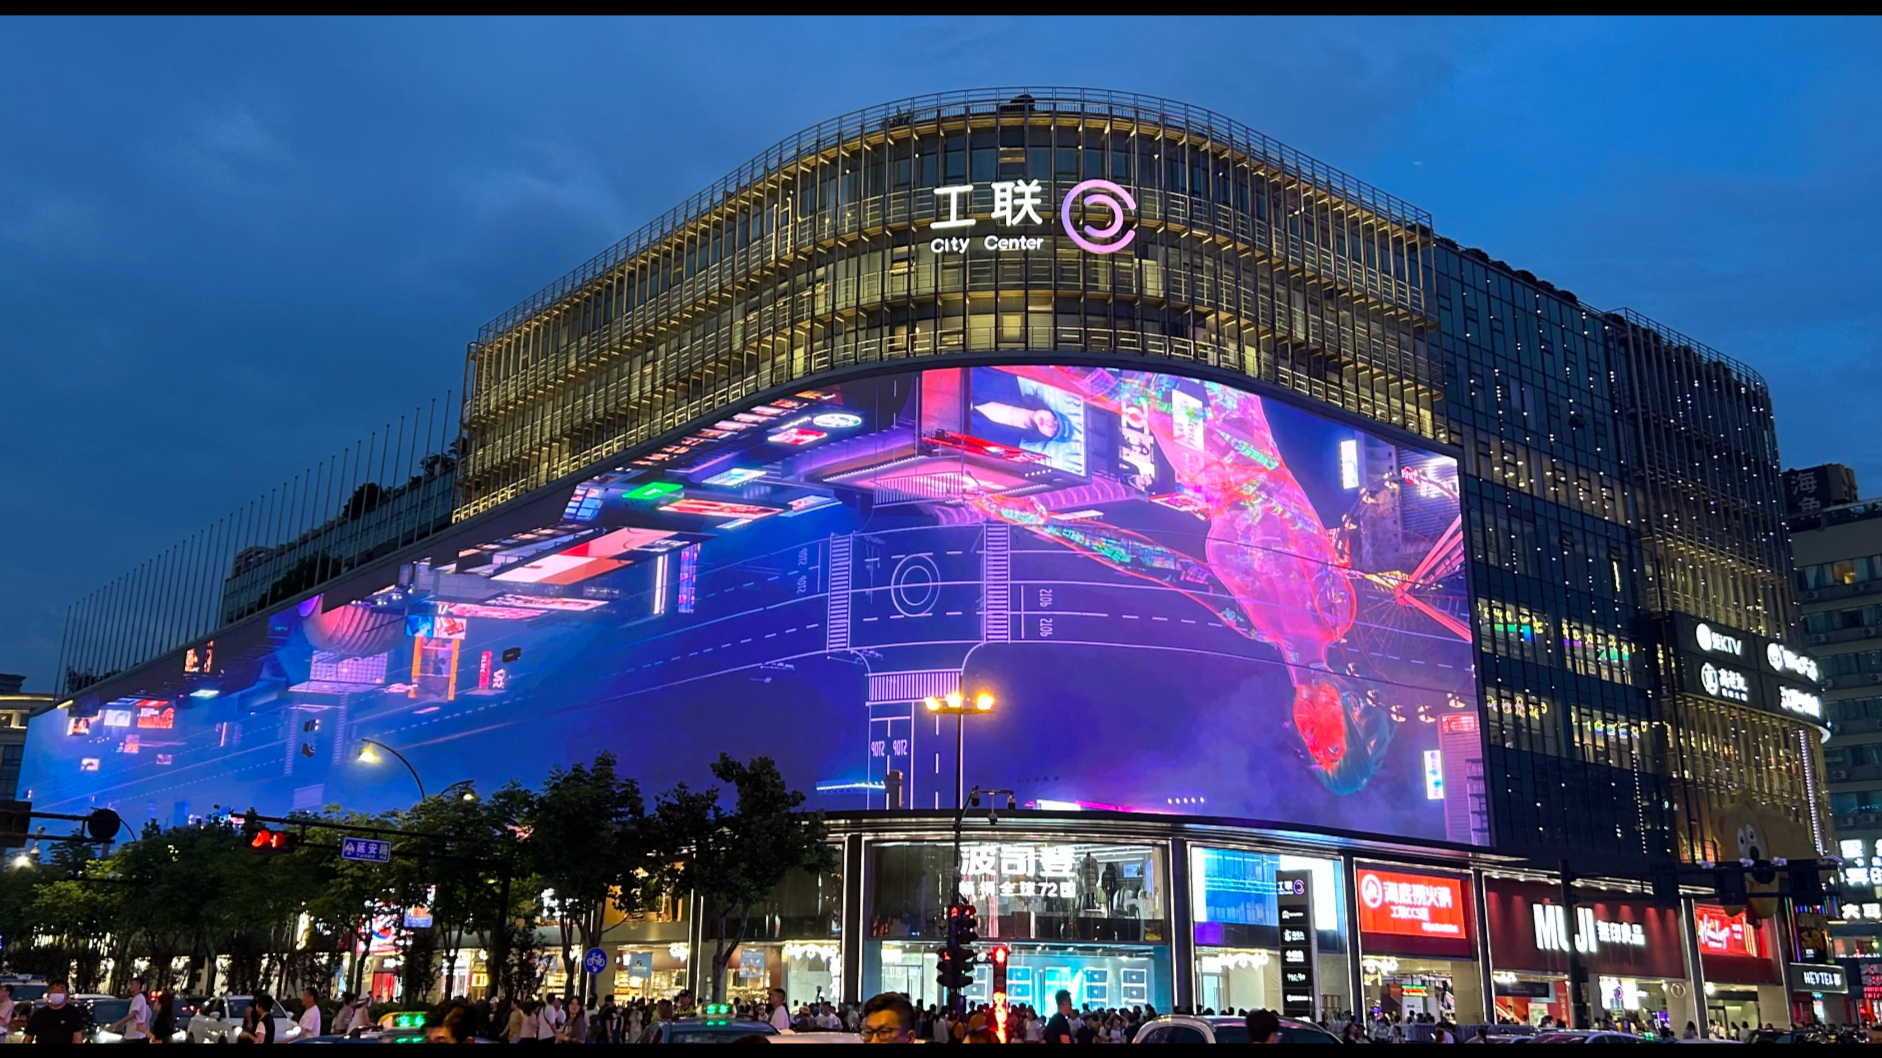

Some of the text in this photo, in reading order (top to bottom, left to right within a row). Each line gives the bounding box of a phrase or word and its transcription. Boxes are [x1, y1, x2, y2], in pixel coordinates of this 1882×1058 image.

[930, 179, 1043, 229] 工联
[930, 235, 1044, 254] City Center
[960, 845, 1076, 877] 波司登
[1383, 882, 1452, 908] 海底捞火锅
